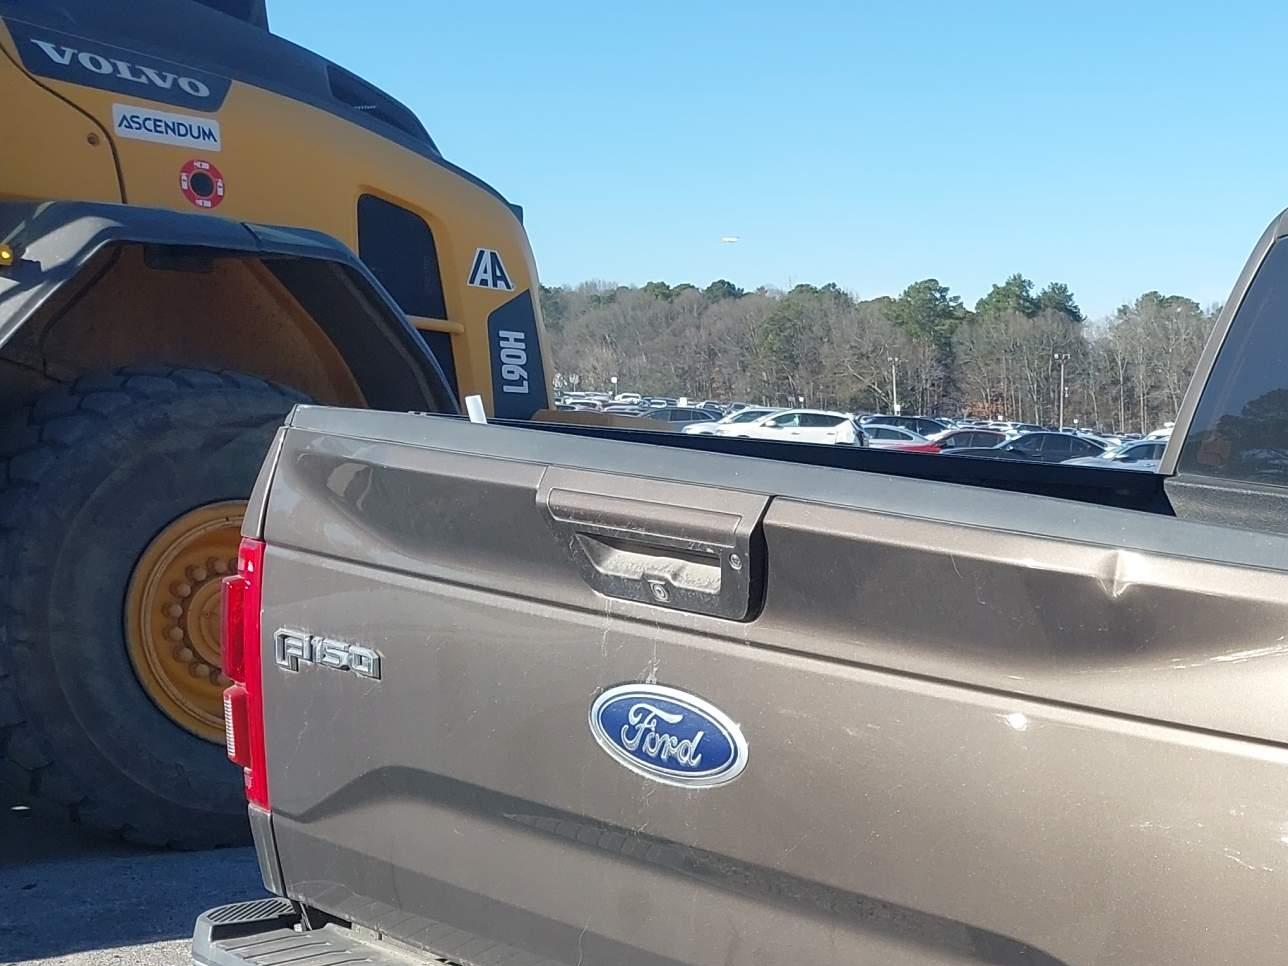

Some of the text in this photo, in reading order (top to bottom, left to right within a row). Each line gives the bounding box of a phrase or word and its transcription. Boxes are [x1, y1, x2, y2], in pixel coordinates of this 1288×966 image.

[30, 38, 211, 98] VOLVO
[117, 113, 218, 144] ASCENDUM
[498, 330, 530, 394] L90H
